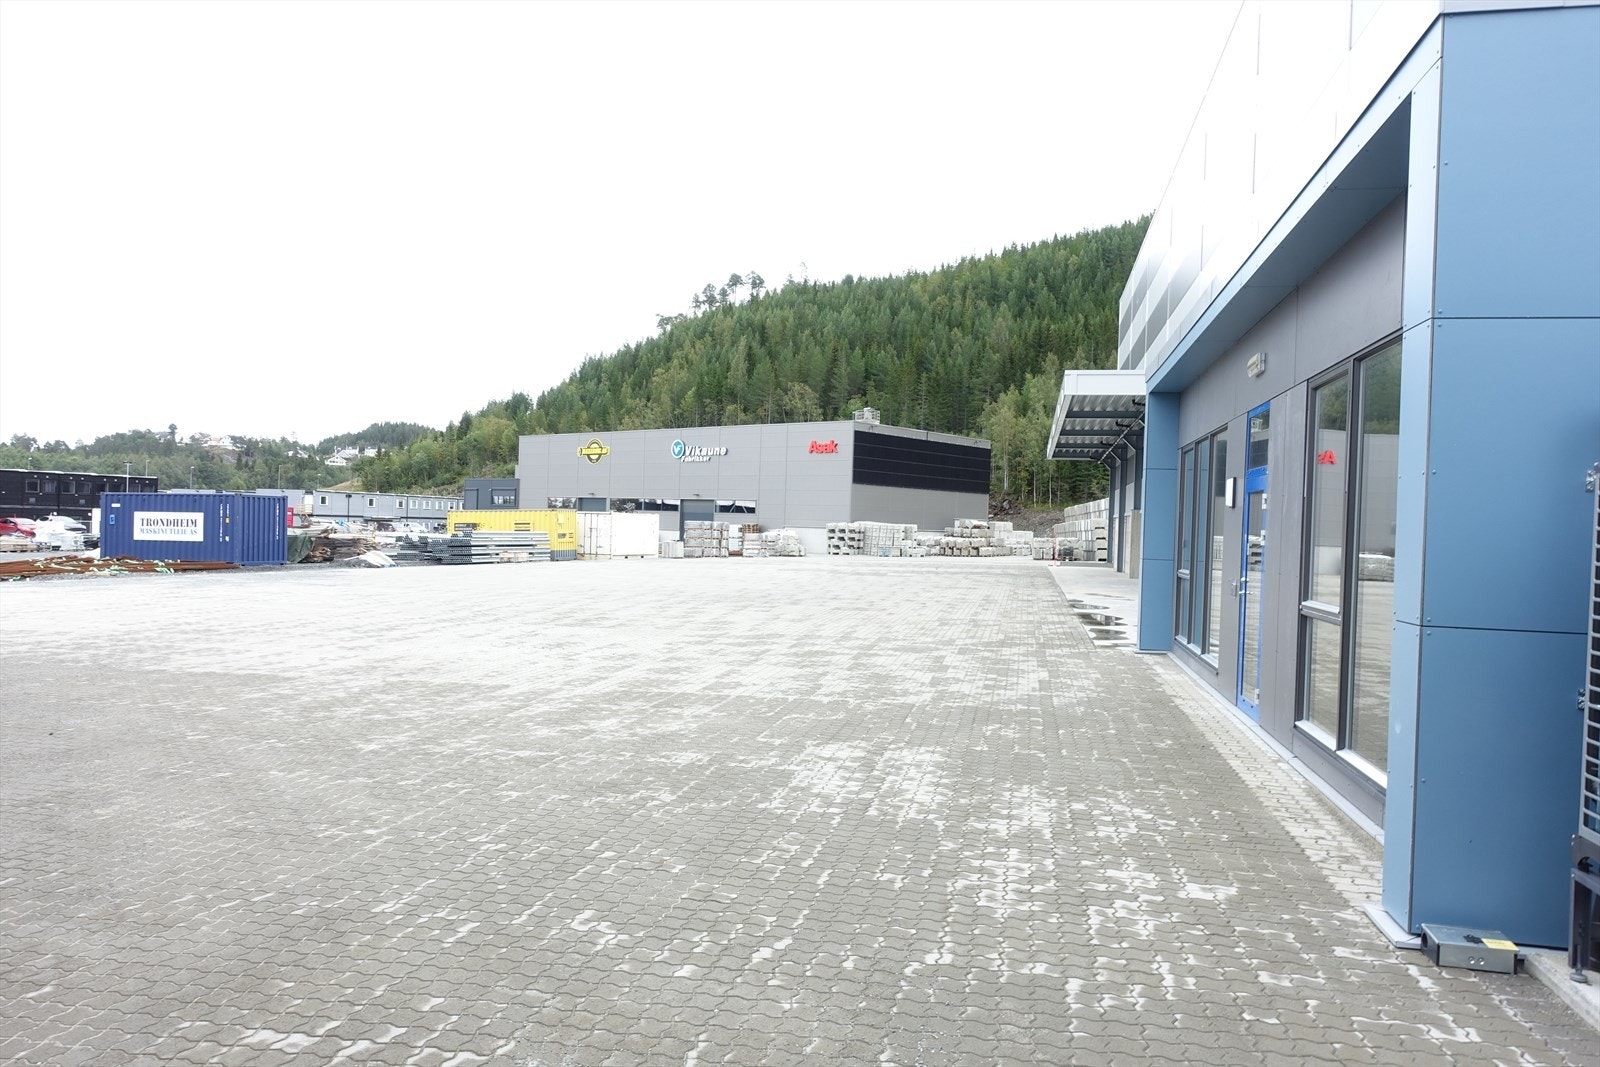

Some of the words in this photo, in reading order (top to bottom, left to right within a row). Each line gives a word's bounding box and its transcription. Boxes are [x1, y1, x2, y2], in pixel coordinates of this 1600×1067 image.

[685, 446, 727, 456] Vikaune
[808, 440, 838, 453] Asak
[140, 518, 198, 527] TRONDHEIM
